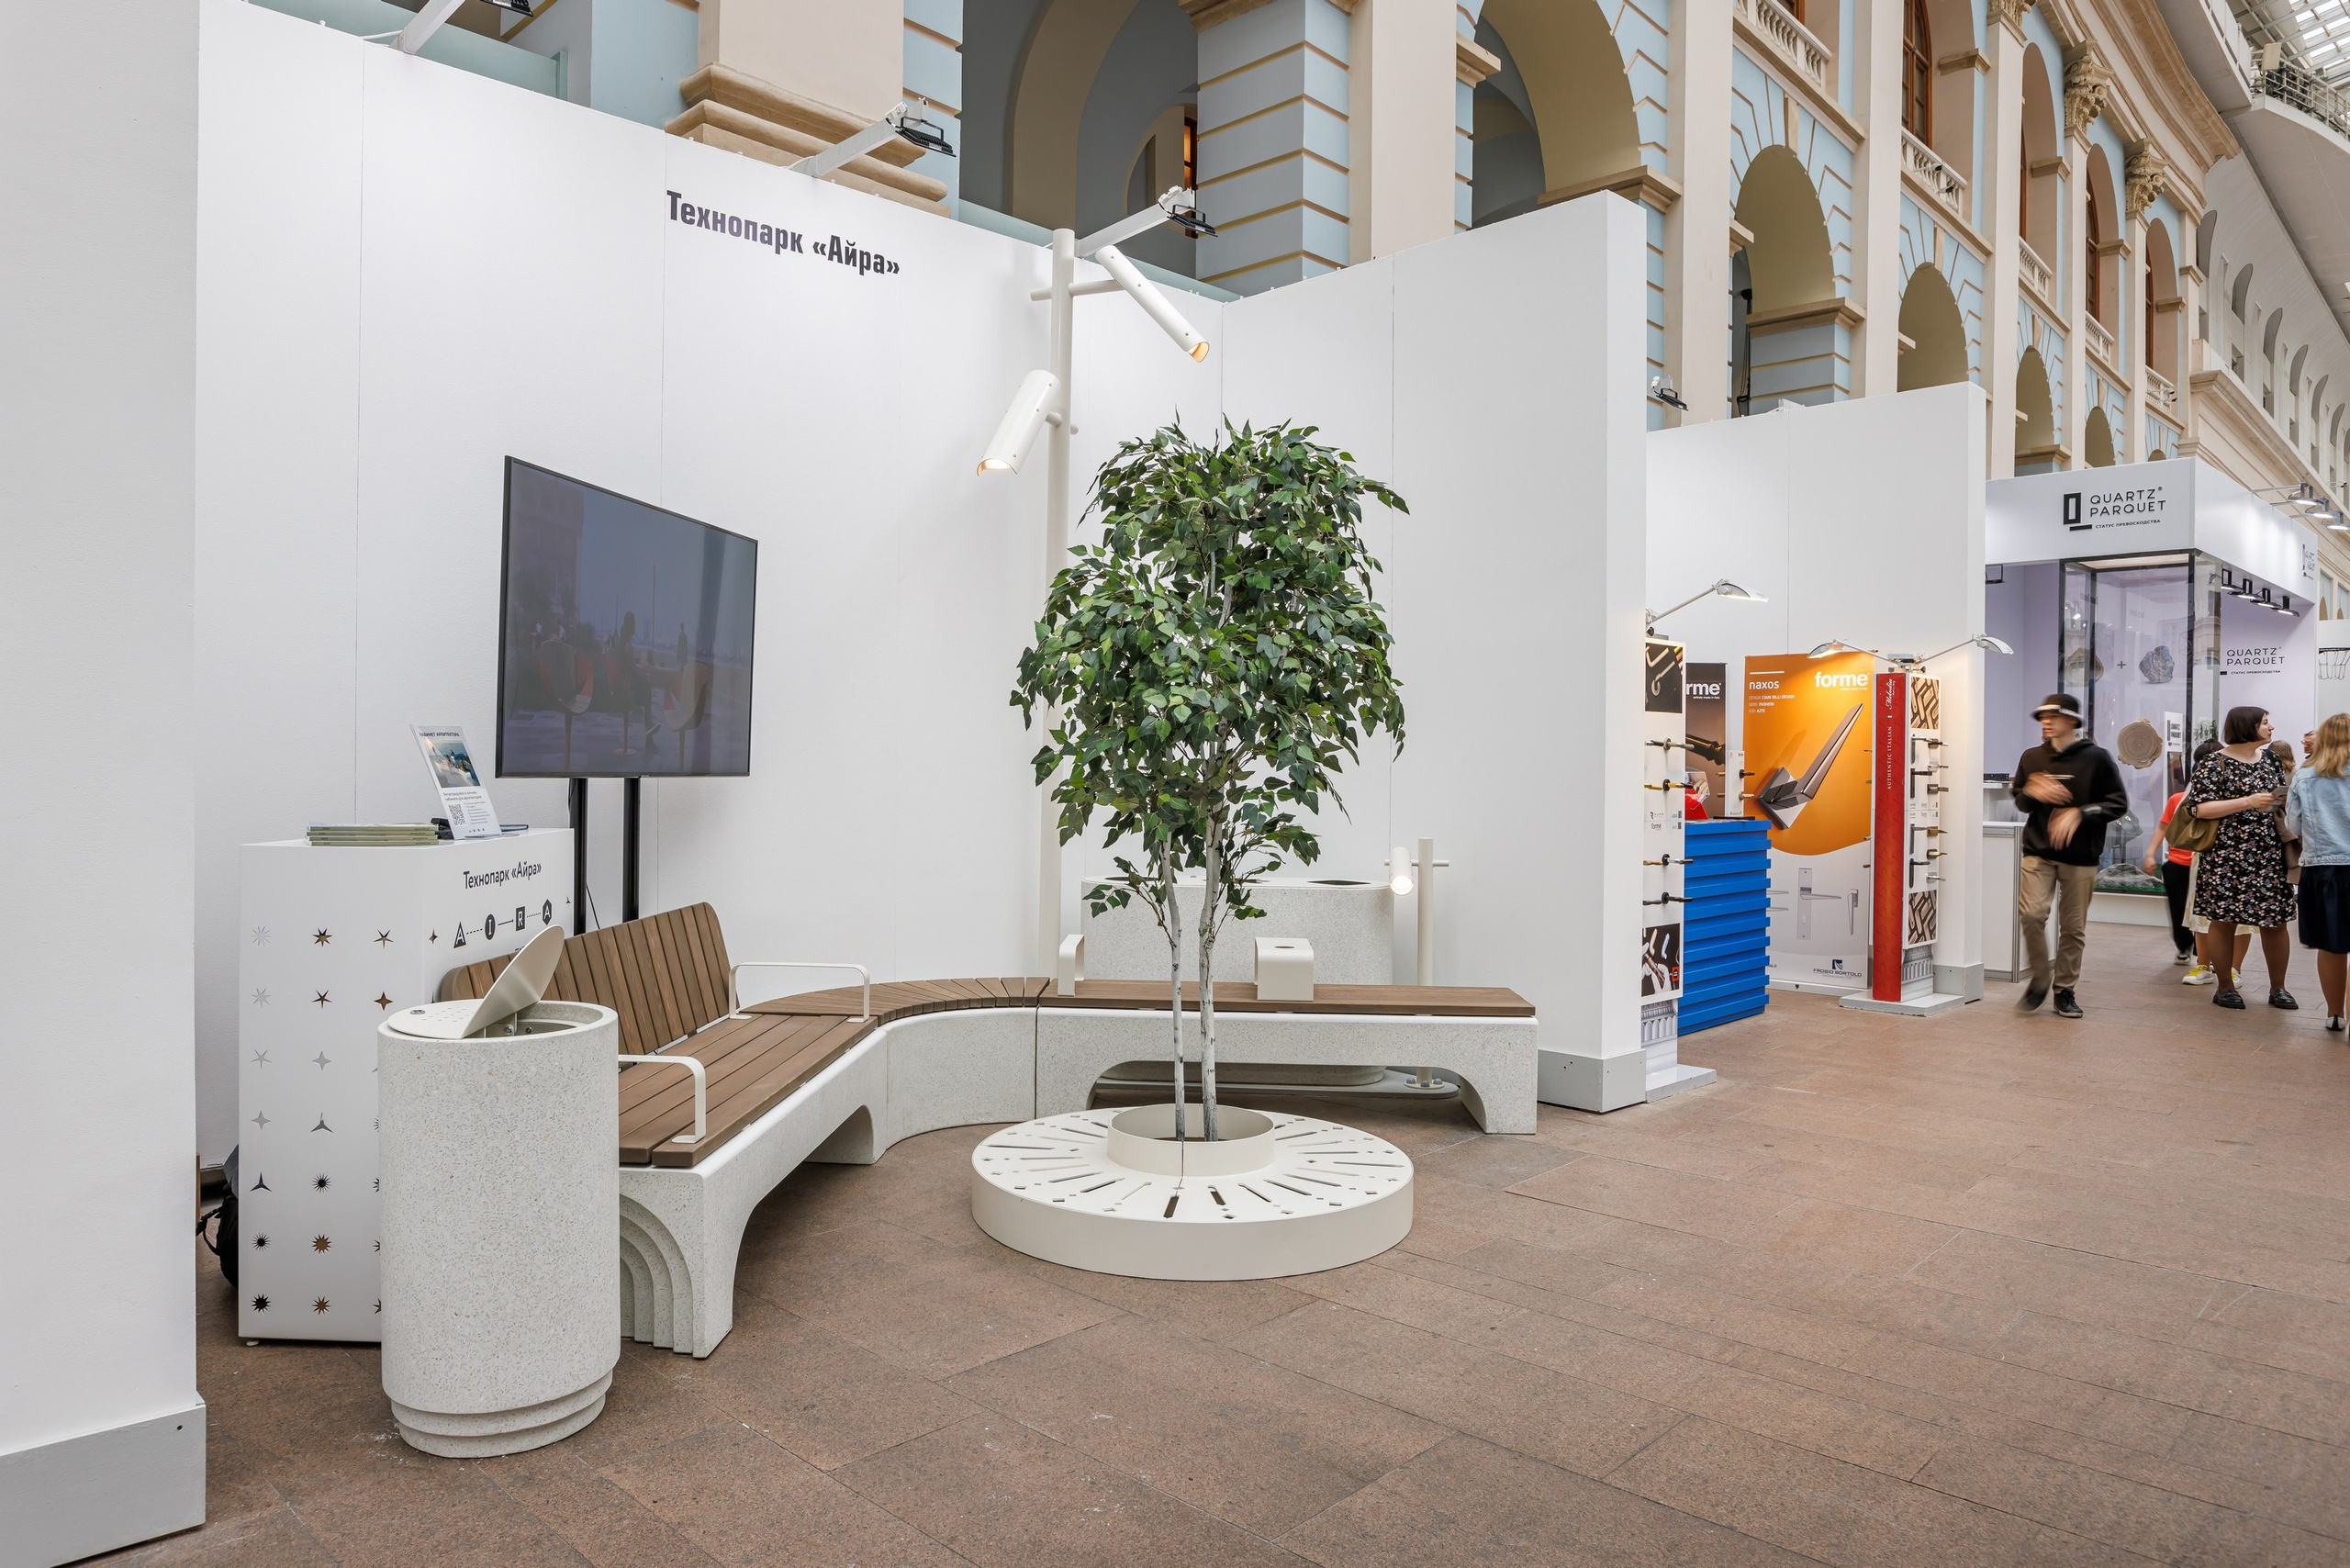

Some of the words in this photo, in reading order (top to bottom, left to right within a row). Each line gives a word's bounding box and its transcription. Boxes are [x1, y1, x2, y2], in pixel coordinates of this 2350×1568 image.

[666, 190, 803, 255] Технопарк
[812, 234, 901, 275] «Айра»
[2090, 488, 2155, 504] QUARTZ
[2090, 500, 2165, 517] PARQUET
[2116, 519, 2161, 527] ПРЕВОСХОДСТВА
[2227, 647, 2277, 656] QUARTZ
[2227, 656, 2285, 666] PARQUET
[1749, 681, 1780, 689] naxos
[1815, 671, 1869, 688] forme
[1686, 682, 1720, 696] rme
[463, 868, 509, 889] Технопарк
[511, 861, 542, 880] «Айра»
